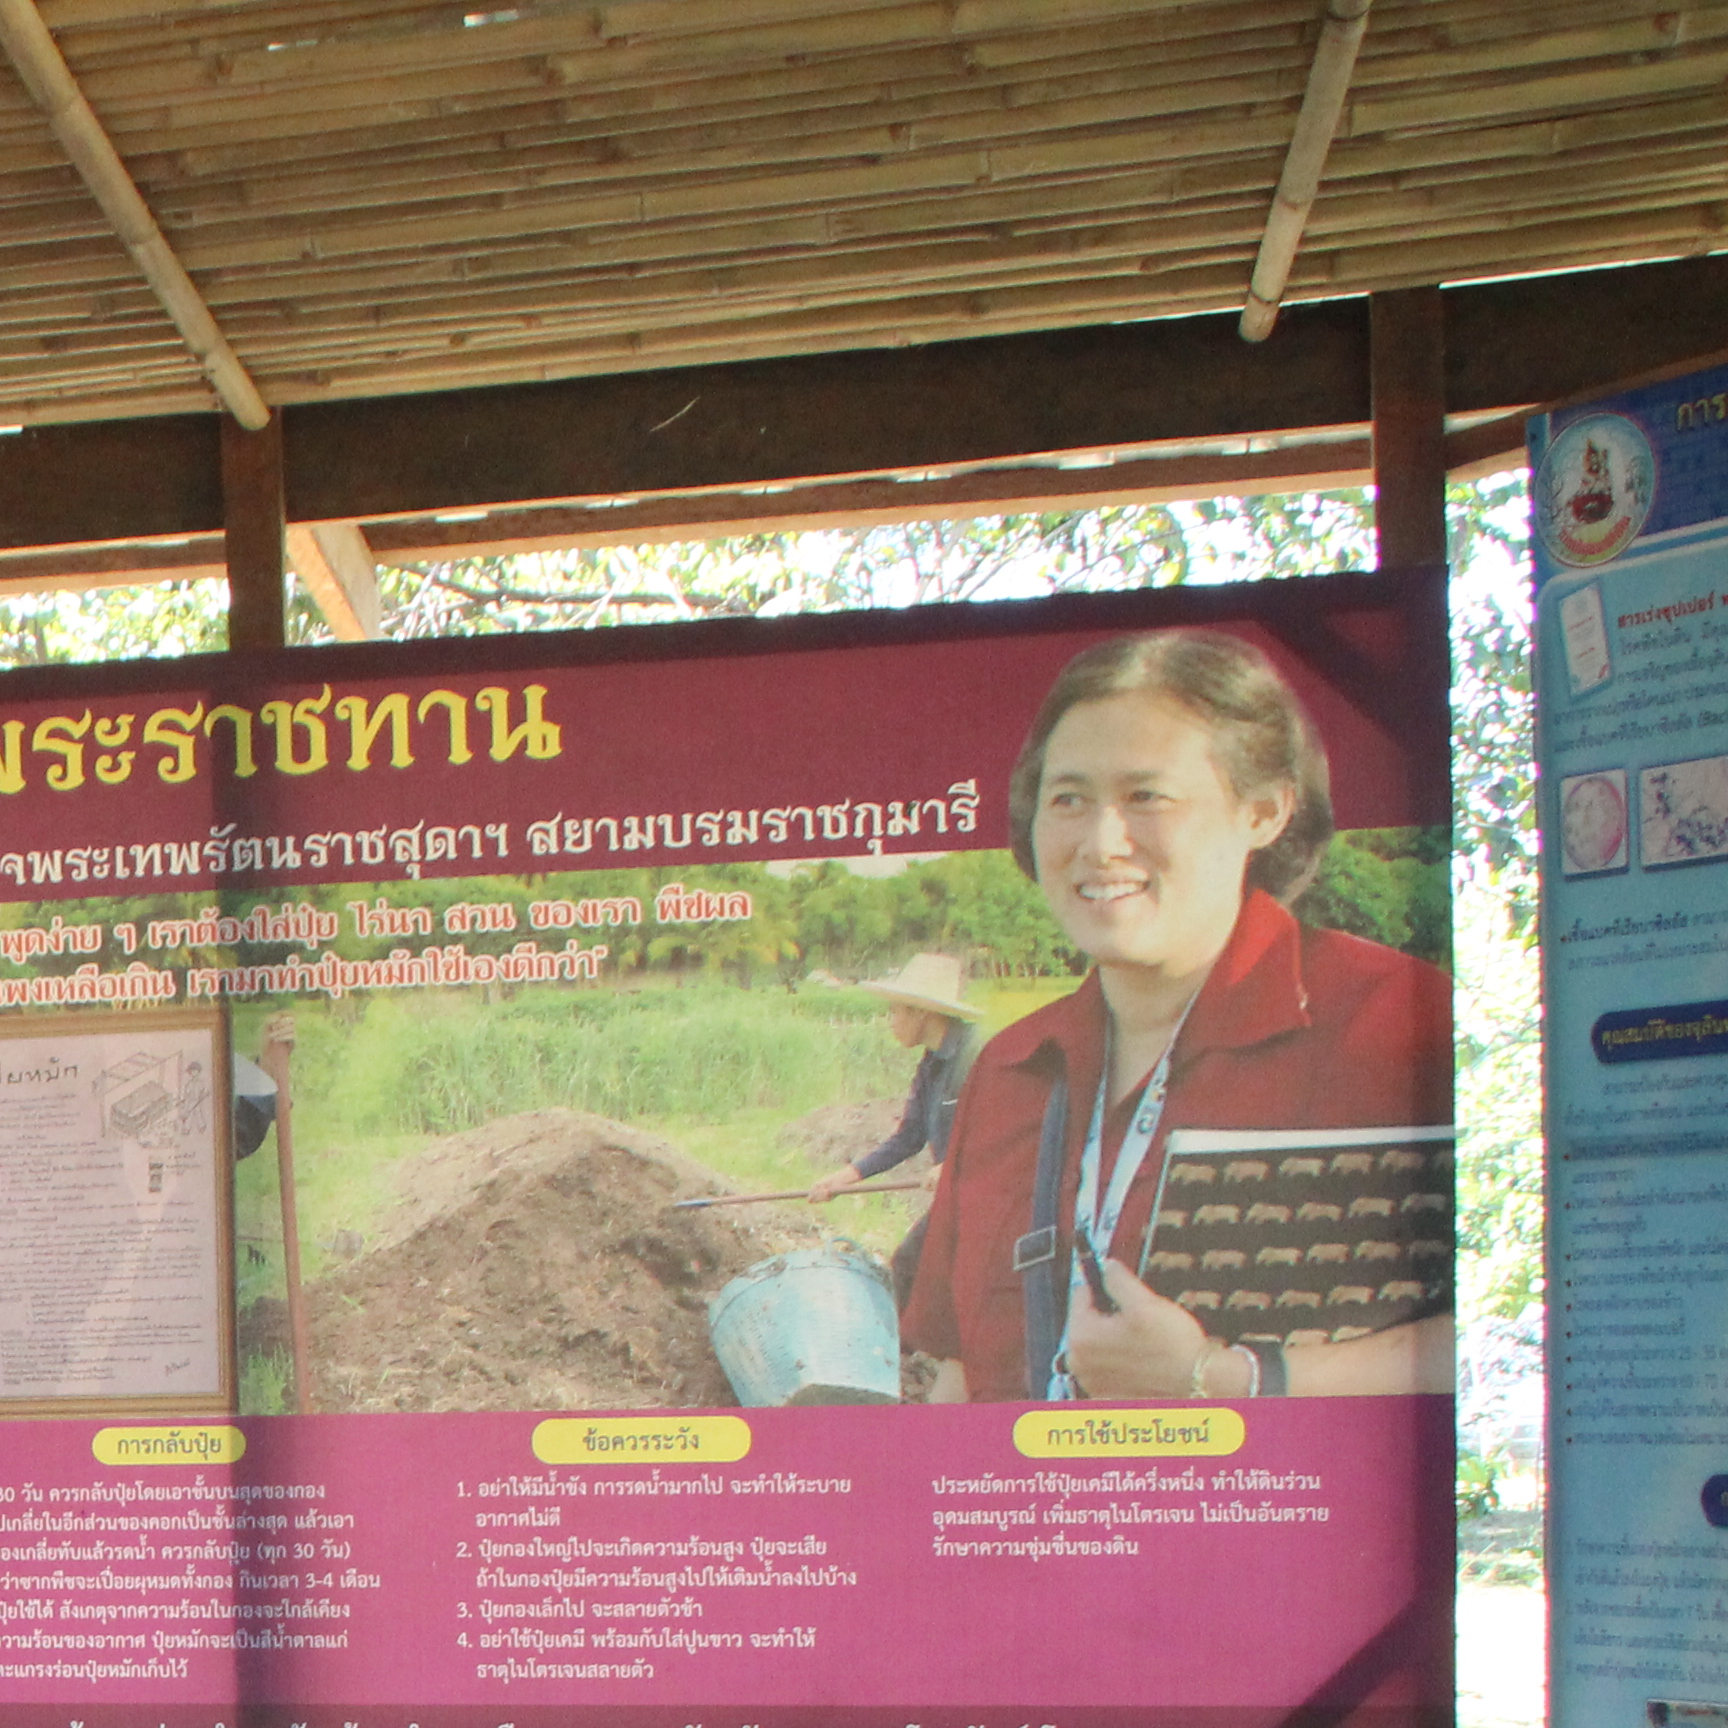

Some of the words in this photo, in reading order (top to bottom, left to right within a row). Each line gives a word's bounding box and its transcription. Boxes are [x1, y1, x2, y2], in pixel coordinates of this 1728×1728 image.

[526, 780, 981, 856] สยามบรมราชกุมารี
[0, 915, 102, 965] พูดง่าย
[114, 921, 136, 954] ๆ
[148, 902, 338, 951] เราต้องใส่ปุ๋ย
[349, 900, 430, 938] ไร่นา
[443, 894, 512, 932] สวน
[531, 894, 641, 928] ของเรา
[655, 885, 752, 923] พืชผล
[117, 1430, 222, 1461] การกลับปุ๋ย
[582, 1426, 700, 1452] ข้อควรระวัง
[1047, 1417, 1210, 1446] การใช้ประโยชน์
[20, 1481, 44, 1503] วัน
[49, 1476, 326, 1508] ควรกลับปุ๋ยโดยเอาชั้นบนสุดของกอง
[457, 1481, 472, 1498] 1.
[478, 1471, 587, 1498] อย่าให้มีน้ำขัง
[593, 1470, 724, 1496] การรดน้ำมากไป
[730, 1472, 852, 1495] จะทำให้ระบาย
[931, 1466, 1205, 1499] ประหยัดการใช้ปุ๋ยเคมีได้ครึ่งหนึ่ง
[1211, 1468, 1321, 1491] ทำให้ดินร่วน
[294, 1507, 355, 1529] แล้วเอา
[475, 1506, 561, 1528] อากาศไม่ดี
[932, 1502, 1037, 1532] อุดมสมบูรณ์
[1043, 1501, 1196, 1530] เพิ่มธาตุไนโตรเจน
[1199, 1499, 1330, 1523] ไม่เป็นอันตราย
[161, 1539, 250, 1566] ควรกลับปุ๋ย
[257, 1543, 287, 1565] (ทุก
[293, 1542, 315, 1559] 30
[320, 1538, 351, 1560] วัน)
[456, 1541, 473, 1558] 2.
[478, 1535, 744, 1564] ปุ๋ยกองใหญ่ไปจะเกิดความร้อนสูง
[749, 1534, 827, 1562] ปุ๋ยจะเสีย
[932, 1530, 1139, 1562] รักษาความชุ่มชื่นของดิน
[240, 1570, 299, 1589] กินเวลา
[305, 1572, 334, 1589] 3-4
[339, 1567, 381, 1589] เดือน
[476, 1561, 857, 1594] ถ้าในกองปุ๋ยมีความร้อนสูงไปให้เติมน้ำลงไปบ้าง
[59, 1598, 351, 1625] สังเกตุจากความร้อนในกองจะใกล้เคียง
[457, 1601, 473, 1618] 3.
[478, 1595, 585, 1625] ปุ๋ยกองเล็กไป
[591, 1596, 703, 1618] จะสลายตัวช้า
[151, 1623, 349, 1655] ปุ๋ยหมักจะเป็นสีน้ำตาลแก่
[456, 1631, 473, 1648] 4.
[479, 1626, 585, 1655] อย่าใช้ปุ๋ยเคมี
[591, 1626, 743, 1654] พร้อมกับใส่ปูนขาว
[749, 1626, 817, 1648] จะทำให้
[476, 1657, 654, 1685] ธาตุไนโตรเจนสลายตัว
